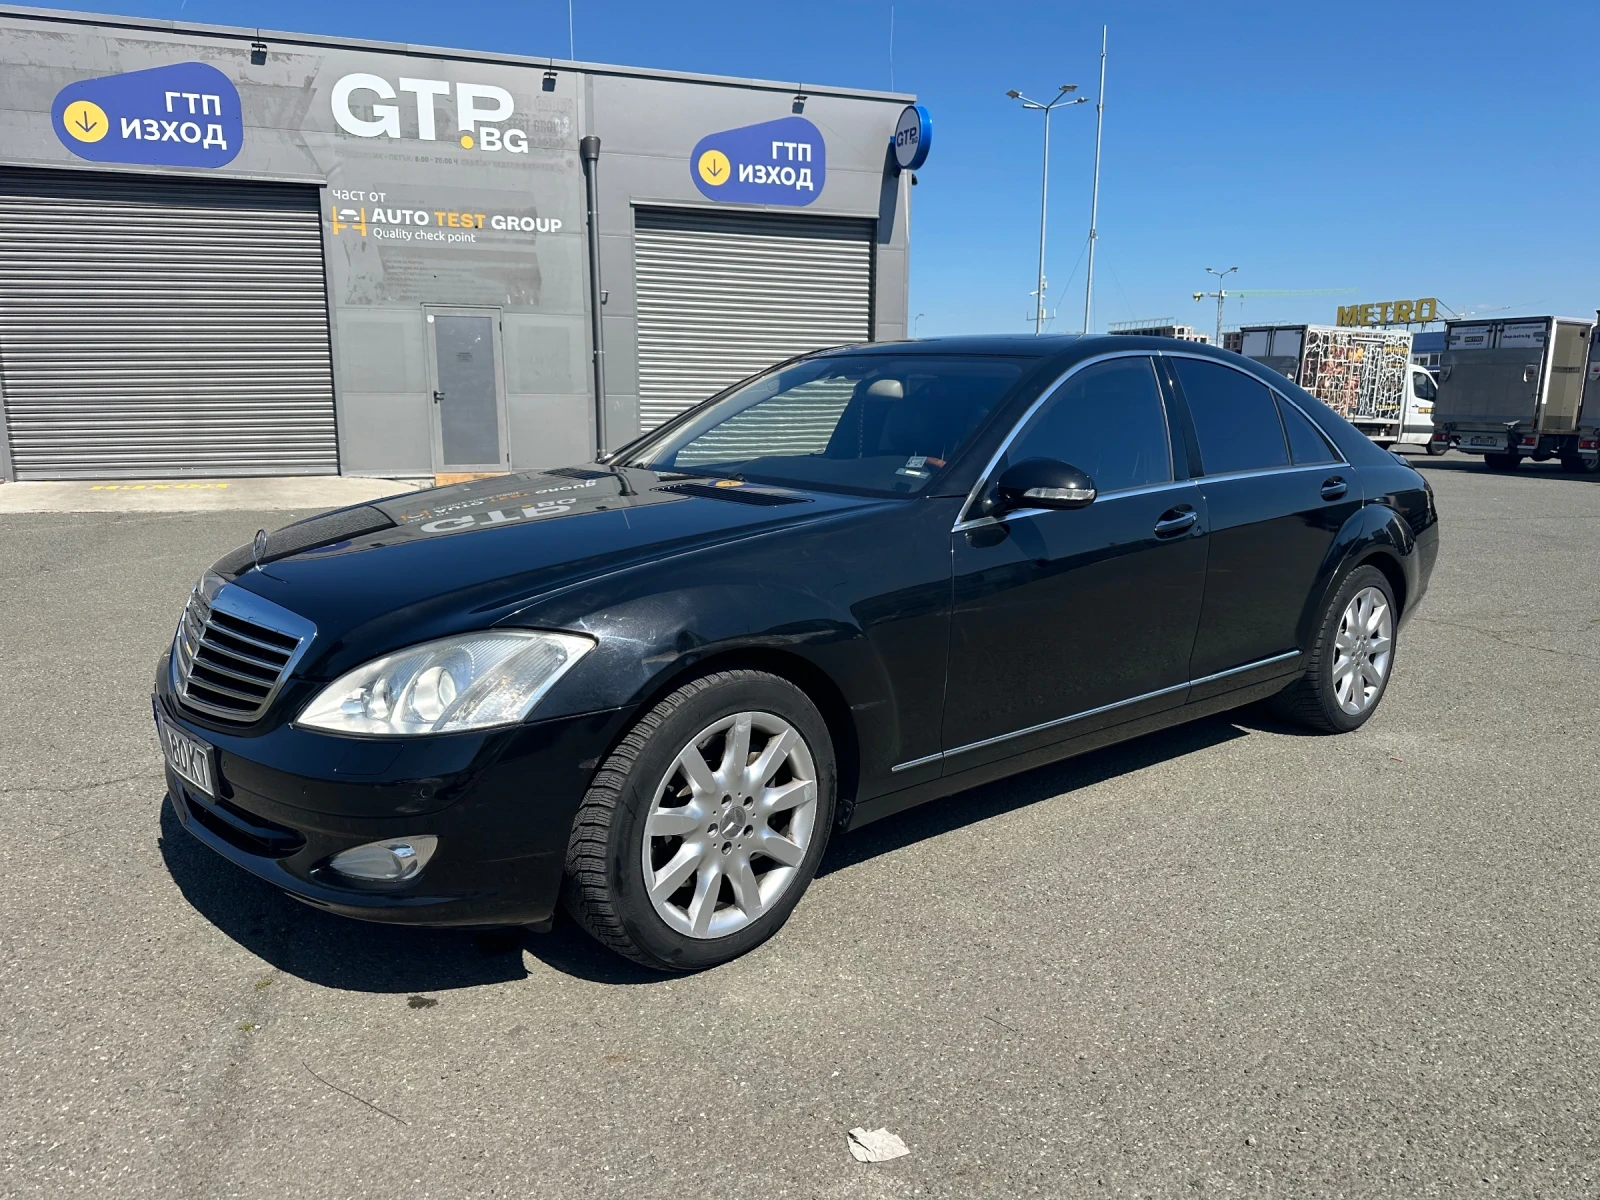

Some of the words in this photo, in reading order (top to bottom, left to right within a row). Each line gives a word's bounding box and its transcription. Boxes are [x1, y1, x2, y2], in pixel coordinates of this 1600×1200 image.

[165, 91, 222, 116] ГТП
[120, 117, 228, 150] ИЗХОД
[771, 141, 812, 162] ГТП
[738, 163, 814, 191] ИЗХОД
[332, 189, 365, 201] част
[371, 207, 430, 226] AUTO
[434, 211, 486, 229] TEST
[491, 215, 562, 233] GROUP
[373, 227, 412, 241] Quality
[414, 229, 446, 242] check
[447, 231, 476, 243] point
[1336, 297, 1437, 327] METRO
